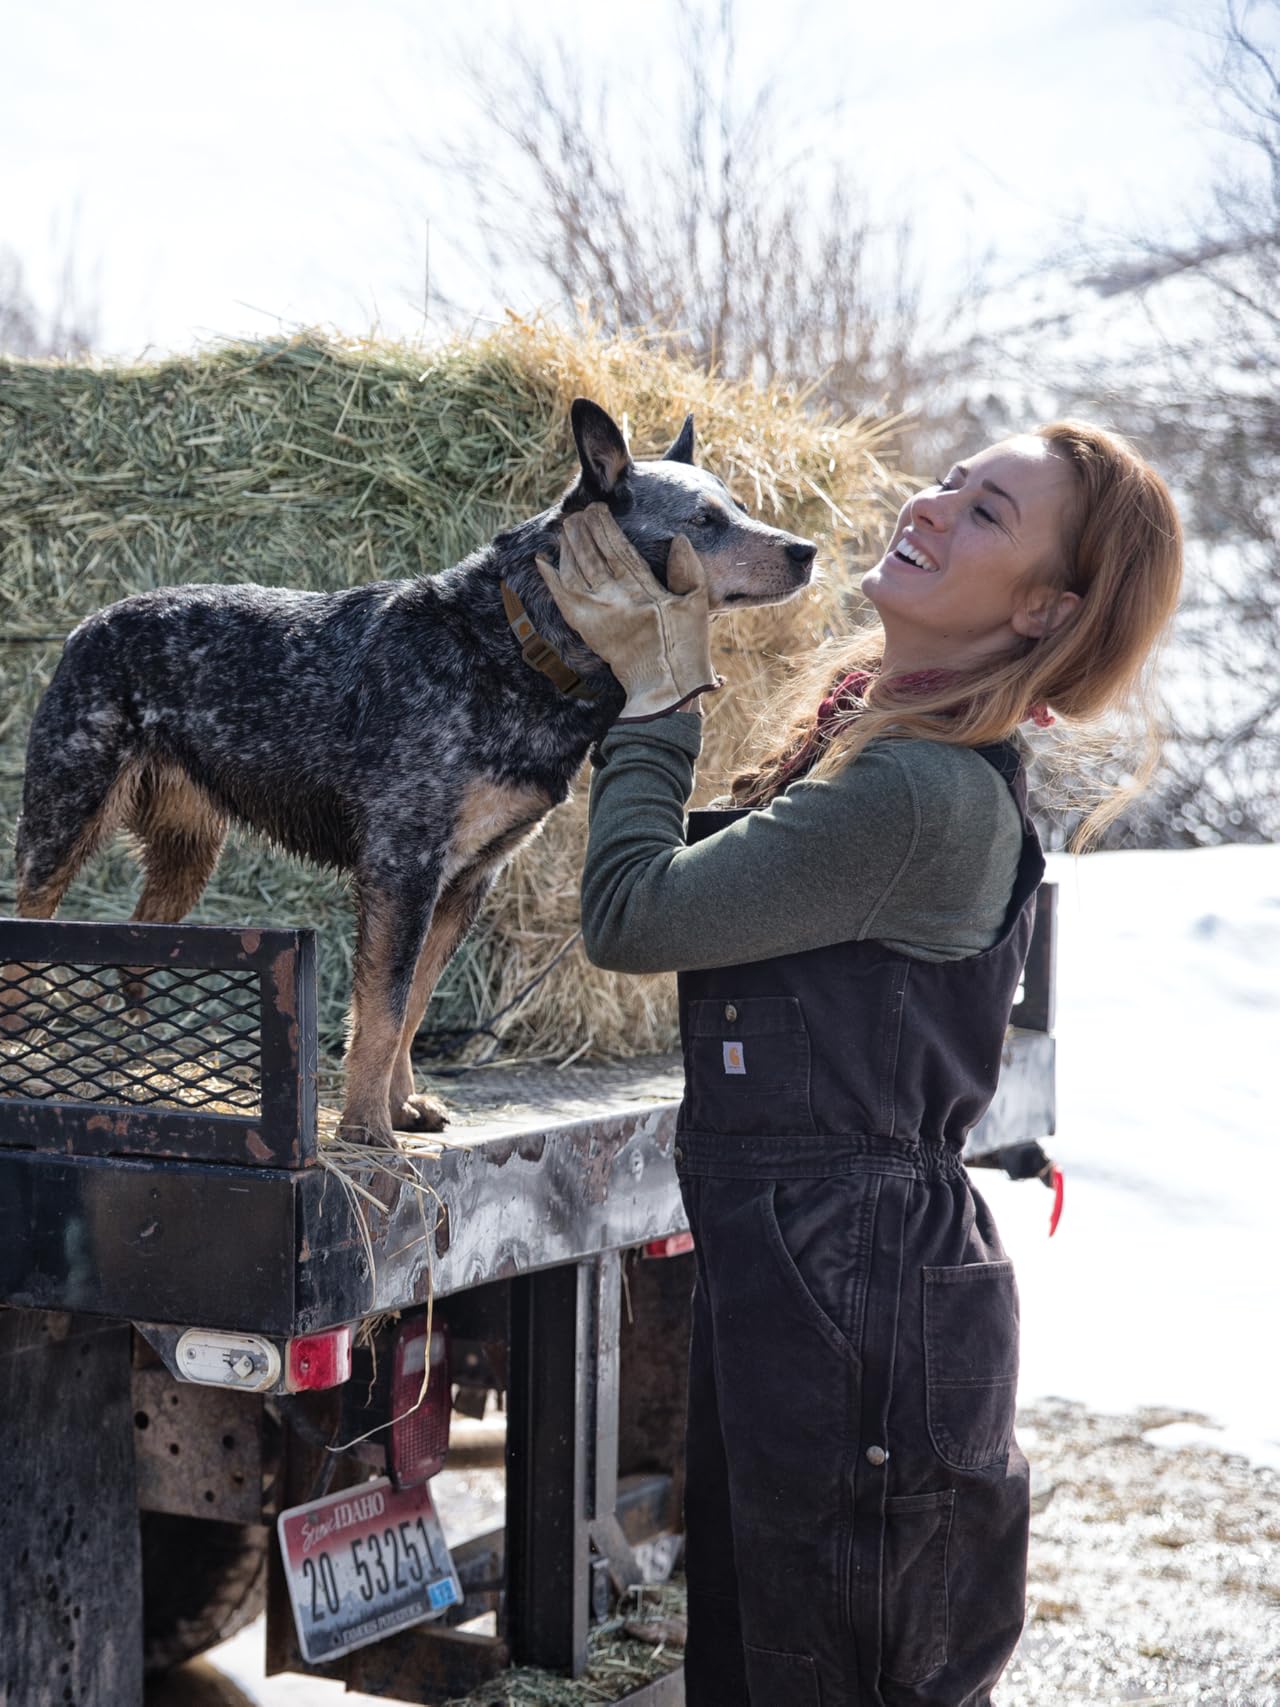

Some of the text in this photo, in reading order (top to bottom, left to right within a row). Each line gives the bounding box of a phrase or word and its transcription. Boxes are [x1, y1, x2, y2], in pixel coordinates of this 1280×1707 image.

[333, 1492, 385, 1530] IDAHO
[302, 1516, 443, 1624] 20 53251
